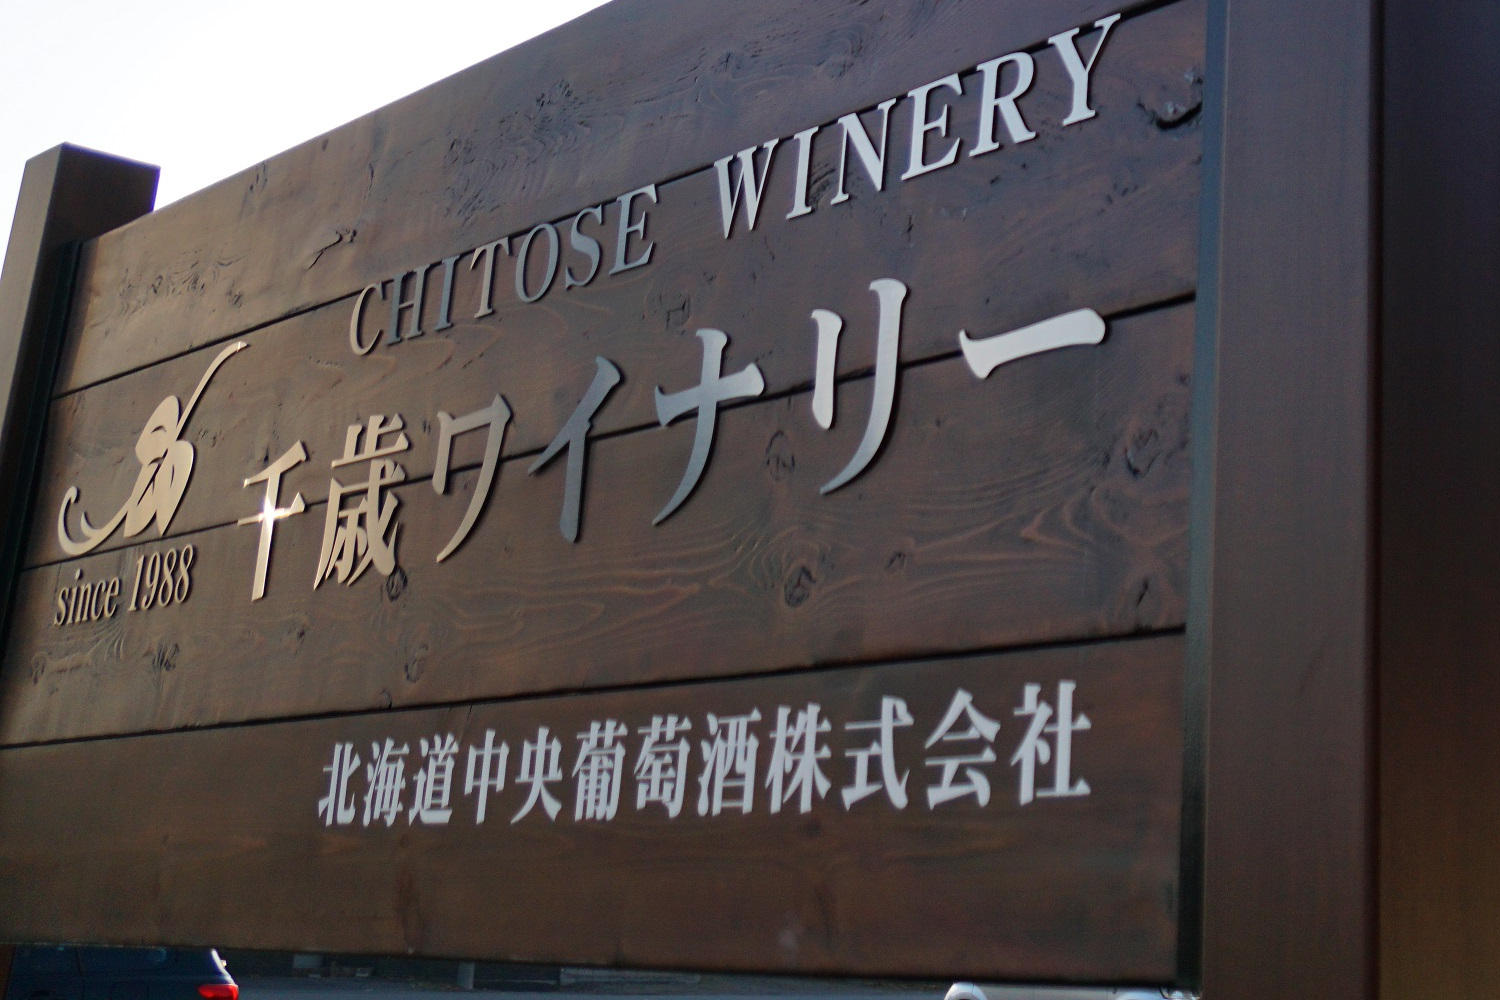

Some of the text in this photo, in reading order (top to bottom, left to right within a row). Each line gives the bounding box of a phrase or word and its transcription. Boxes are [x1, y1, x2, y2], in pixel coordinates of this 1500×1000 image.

[350, 13, 1122, 357] CHITOSE WINERY
[237, 278, 1107, 602] 千歳ワイナリー
[54, 543, 195, 628] since 1988
[318, 679, 1093, 829] 北海道中央葡萄酒株式会社
